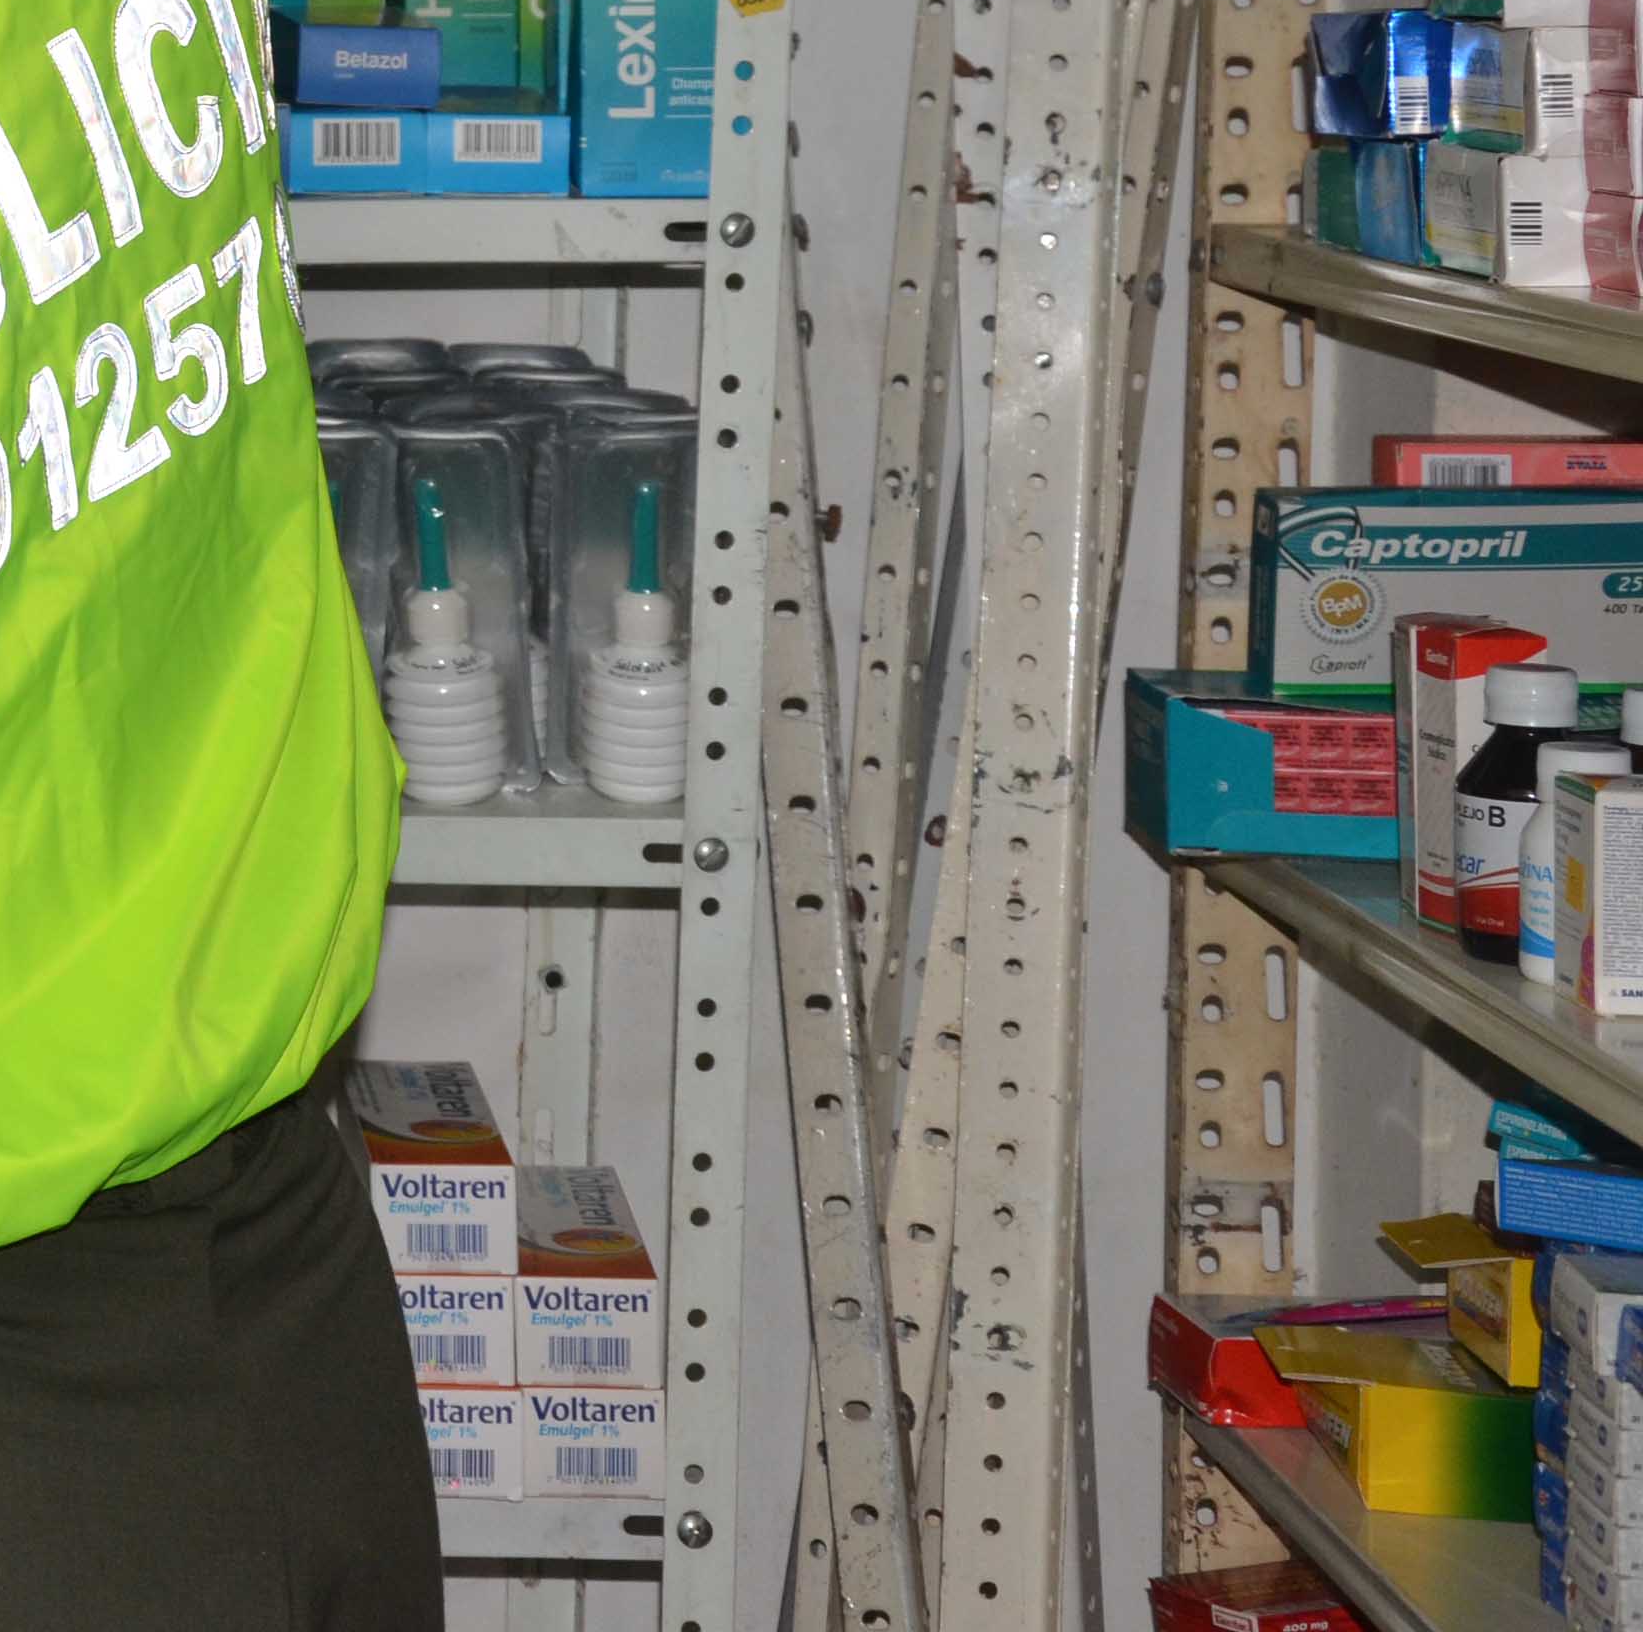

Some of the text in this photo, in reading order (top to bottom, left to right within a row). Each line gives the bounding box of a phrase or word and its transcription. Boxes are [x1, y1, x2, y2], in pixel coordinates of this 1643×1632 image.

[334, 50, 408, 71] Betazol
[1310, 530, 1528, 565] Captopril
[1322, 593, 1364, 617] BpM
[1603, 603, 1627, 615] 400
[1488, 805, 1506, 828] B
[381, 1174, 506, 1199] Voltaren
[389, 1199, 470, 1216] Emulgel 1%
[524, 1285, 649, 1312] Voltaren
[449, 1311, 469, 1324] 1%
[531, 1312, 613, 1329] Emulgel 1%
[531, 1396, 656, 1422] Voltaren
[457, 1425, 477, 1438] 1%
[538, 1423, 620, 1439] Emulgel 1%
